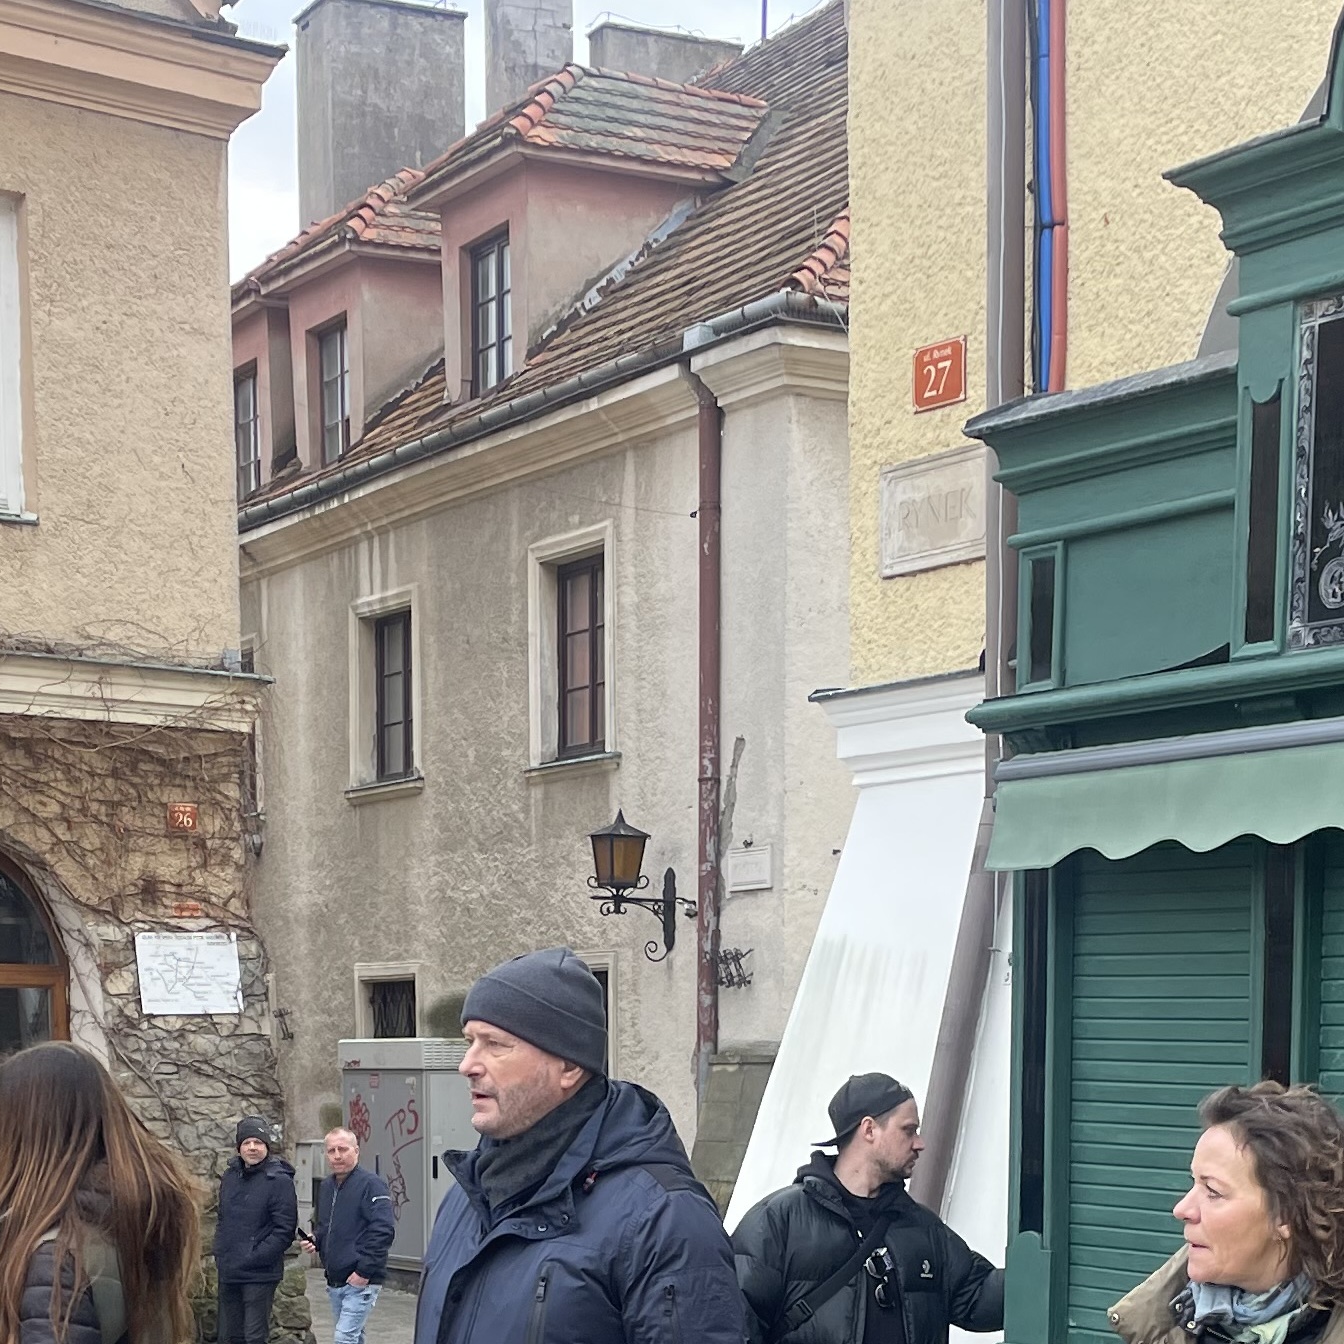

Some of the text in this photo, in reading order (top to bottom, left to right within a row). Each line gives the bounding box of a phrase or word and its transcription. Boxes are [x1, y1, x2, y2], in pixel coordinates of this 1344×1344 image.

[922, 360, 953, 399] 27
[897, 484, 977, 533] RYNEK
[174, 811, 194, 829] 26
